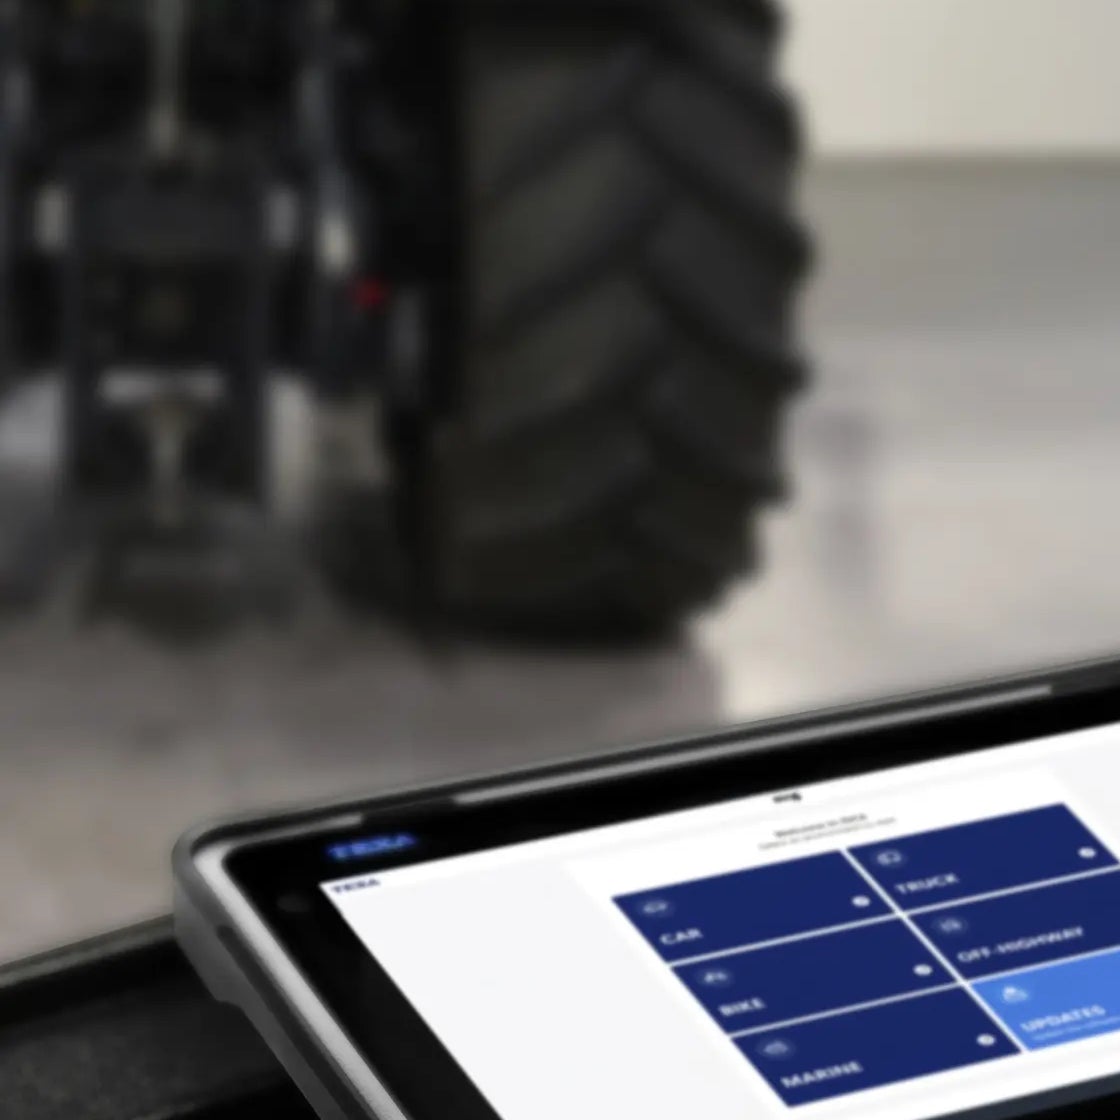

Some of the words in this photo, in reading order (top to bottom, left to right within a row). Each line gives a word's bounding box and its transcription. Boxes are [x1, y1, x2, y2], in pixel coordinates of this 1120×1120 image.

[895, 873, 959, 895] TRUCK
[660, 927, 703, 946] CAR
[719, 997, 766, 1017] BIKE
[1020, 1004, 1107, 1033] UPDATES
[781, 1059, 864, 1089] MARINE
